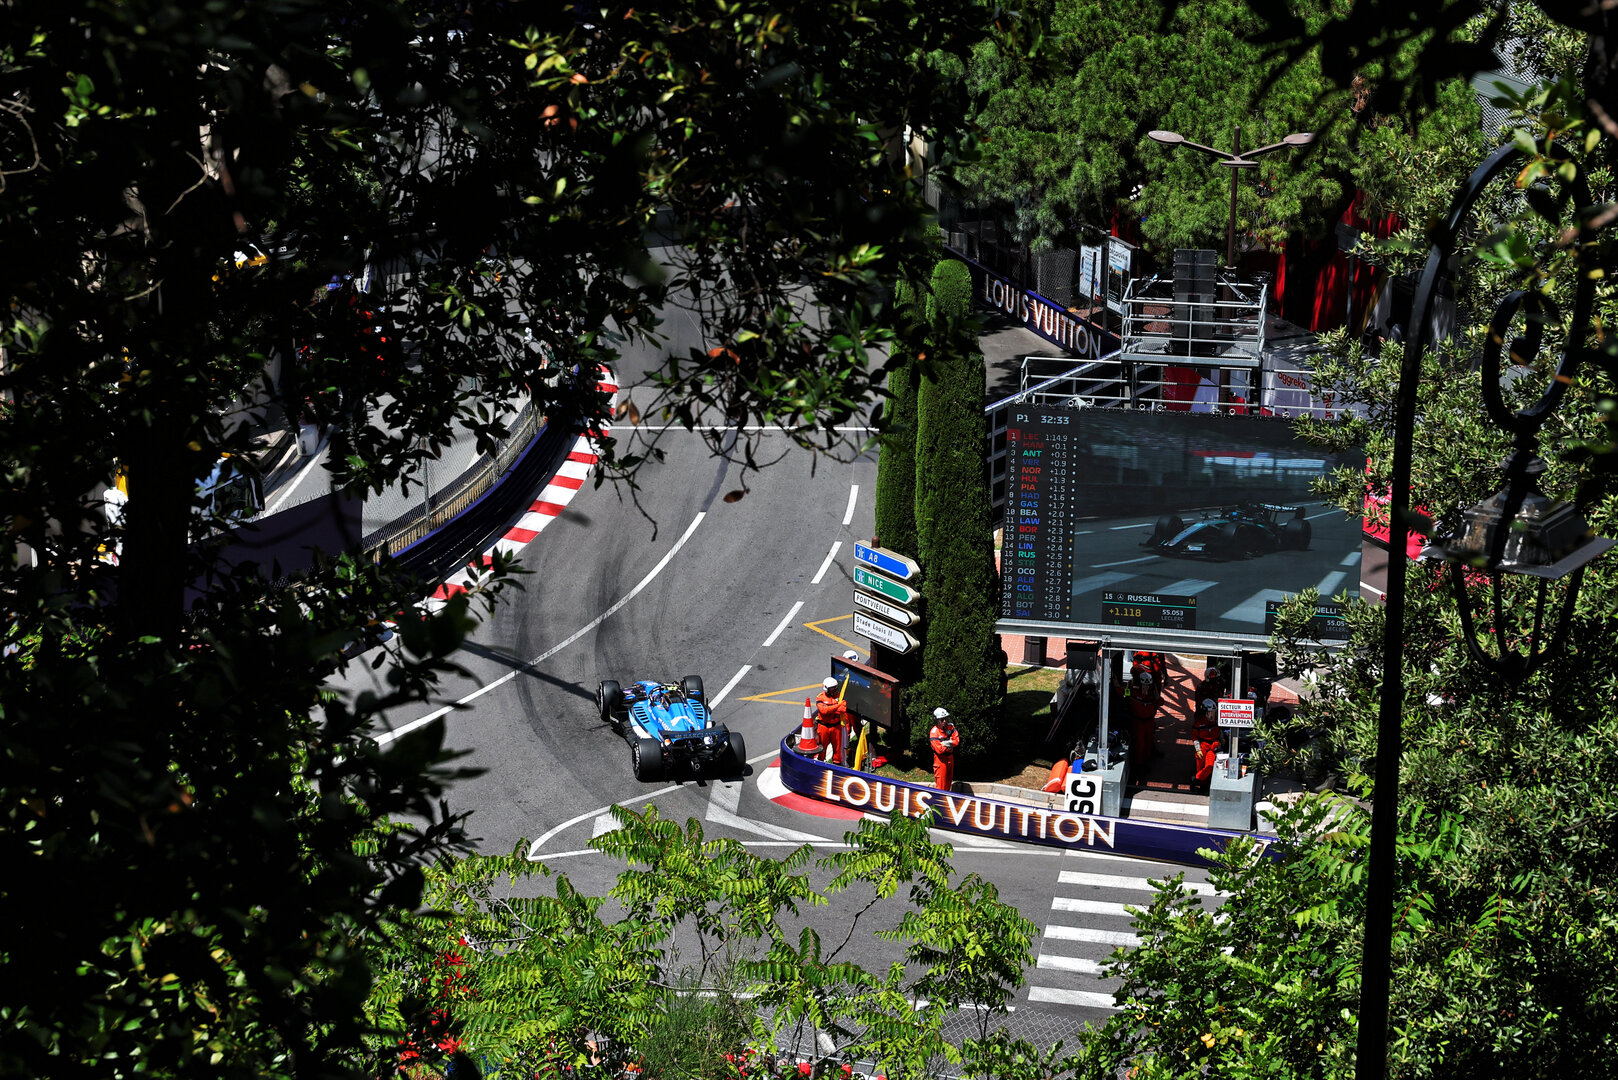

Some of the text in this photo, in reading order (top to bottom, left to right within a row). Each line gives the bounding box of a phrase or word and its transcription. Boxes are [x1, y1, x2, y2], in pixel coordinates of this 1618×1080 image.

[985, 273, 1101, 359] LOUIS VUITTON
[1278, 372, 1306, 389] aggreko
[1016, 414, 1070, 424] P1 32:33
[869, 552, 878, 563] A8
[868, 576, 883, 590] NICE
[856, 594, 890, 614] FONTVIEILLE
[1127, 594, 1160, 602] RUSSELL
[1109, 608, 1141, 617] +1.118
[856, 616, 871, 627] Stade
[872, 623, 886, 634] Louis
[856, 625, 867, 634] Centre
[867, 630, 886, 642] Commercial
[1068, 780, 1096, 814] SC
[826, 770, 1116, 848] LOUIS VUITTON
